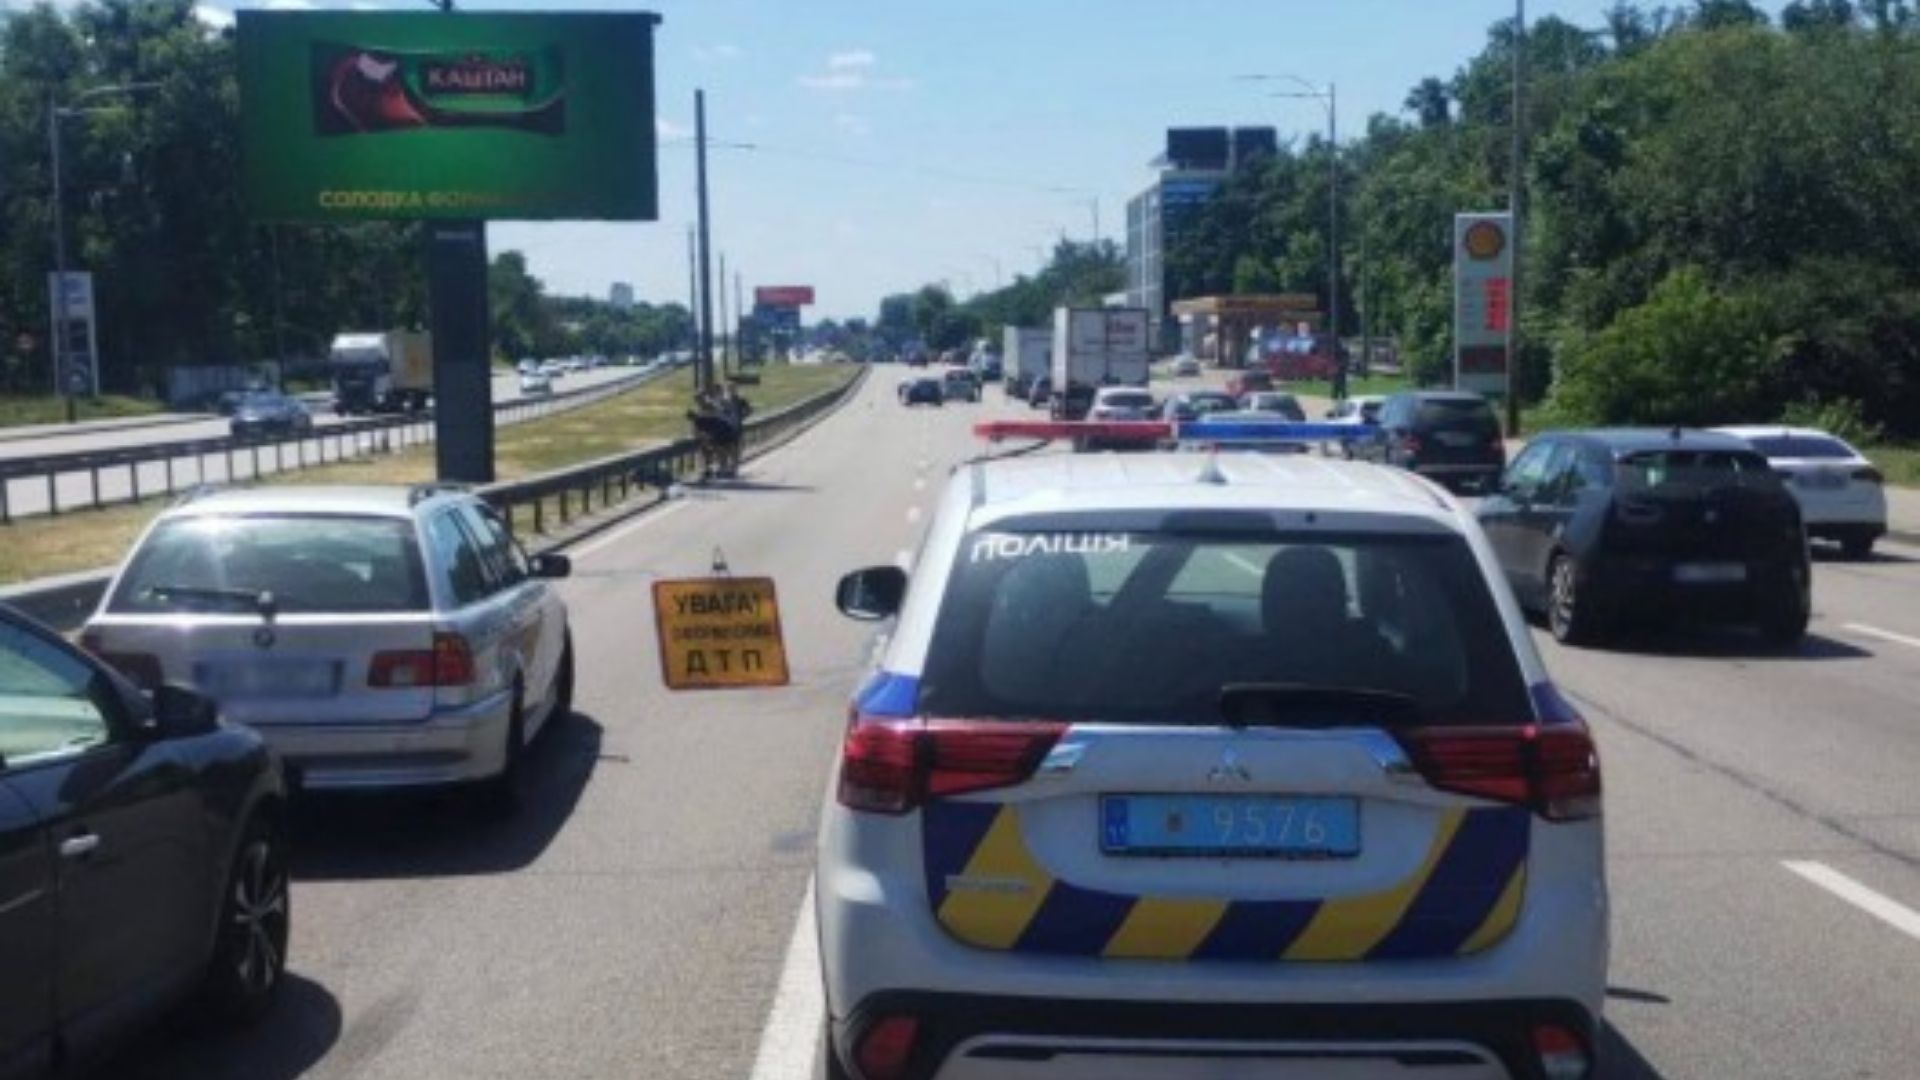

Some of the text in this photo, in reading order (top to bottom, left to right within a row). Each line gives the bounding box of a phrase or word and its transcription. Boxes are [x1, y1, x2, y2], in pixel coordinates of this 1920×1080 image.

[427, 69, 526, 89] КАШТАН
[970, 532, 1129, 563] ПОЛІЦІЯ
[1213, 805, 1325, 846] 9576
